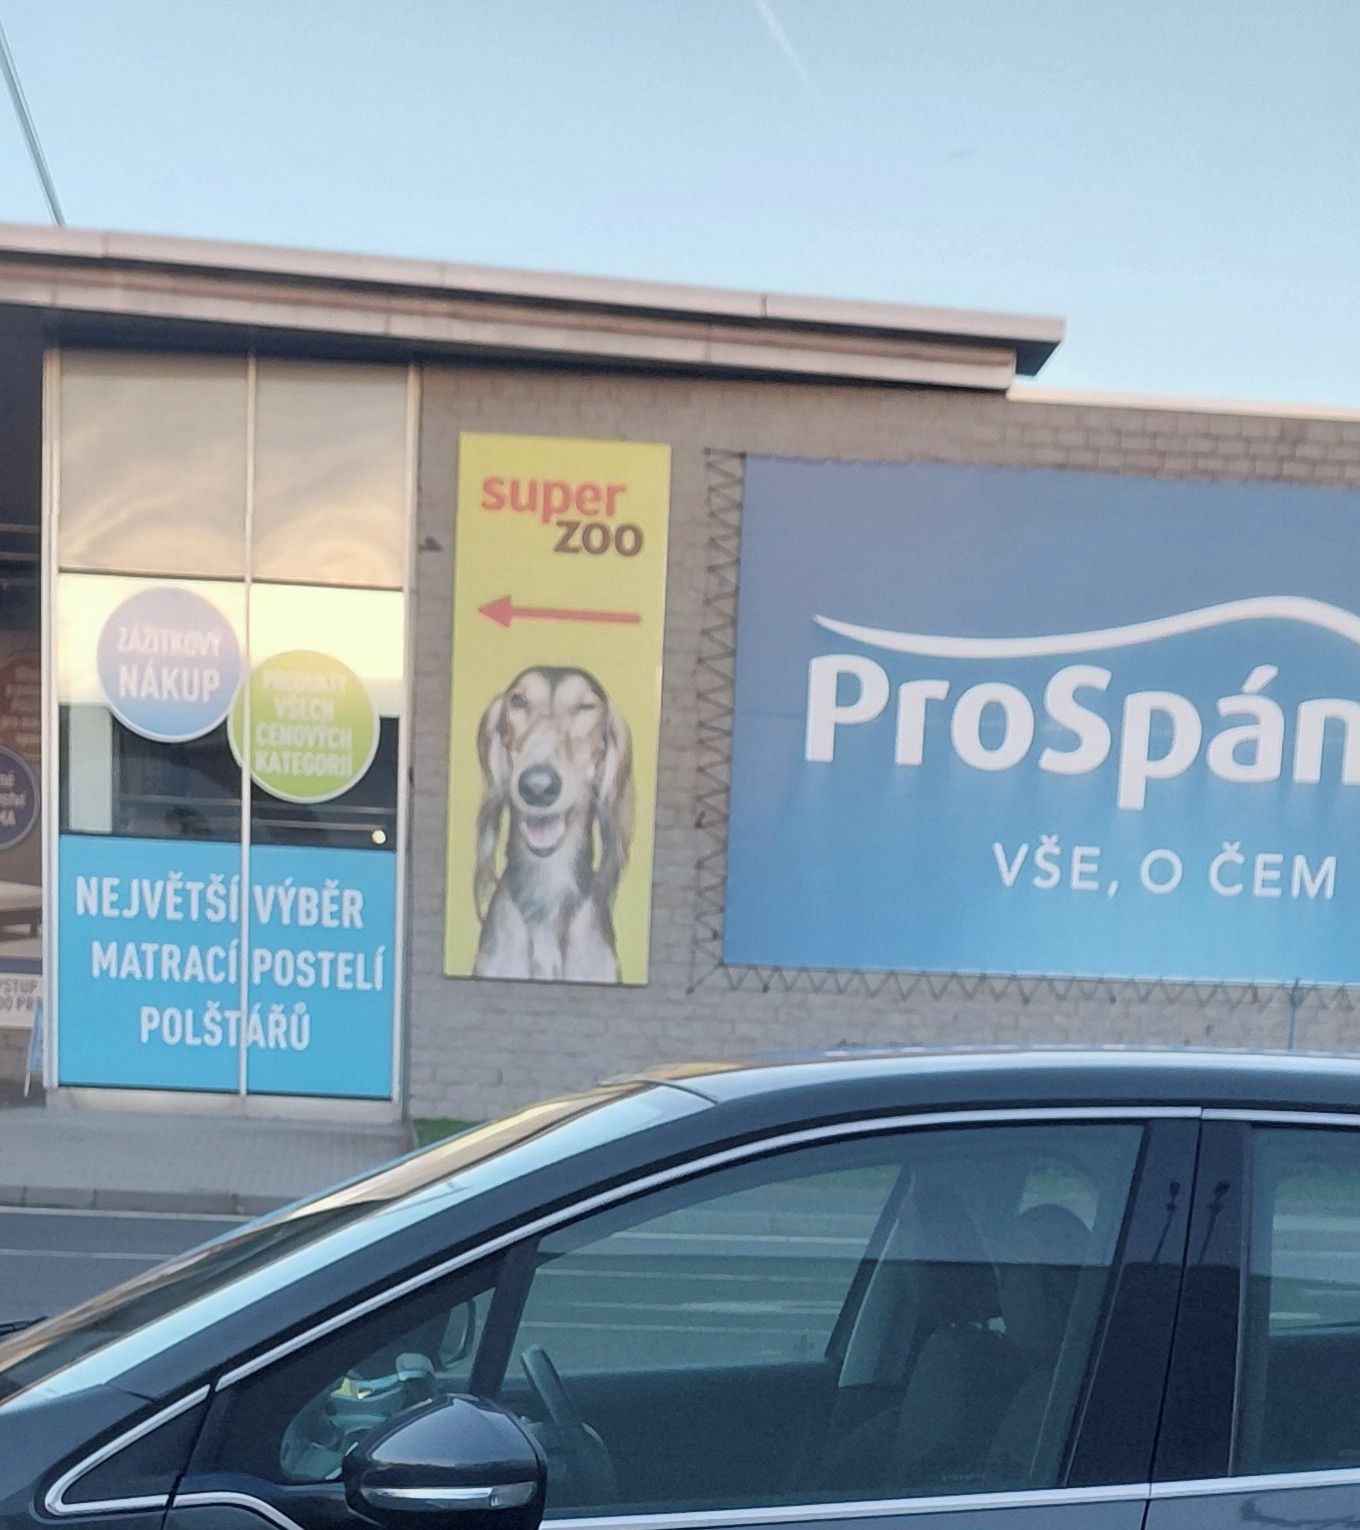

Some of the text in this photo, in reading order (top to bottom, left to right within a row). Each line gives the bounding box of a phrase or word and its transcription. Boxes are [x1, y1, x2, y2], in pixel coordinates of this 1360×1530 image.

[481, 477, 626, 524] super
[117, 624, 222, 657] ZÁŽITKOVÝ
[119, 660, 220, 703] NÁKUP
[255, 722, 353, 750] CENOVÝCH
[992, 834, 1118, 898] VŠE,
[1140, 849, 1183, 894] O
[1208, 840, 1336, 899] ČEM
[76, 870, 364, 929] NEJVĚTŠÍ VÝBĚR
[91, 938, 386, 992] MATRACÍ POSTELÍ
[140, 1000, 311, 1051] POLŠTÁŘŮ
